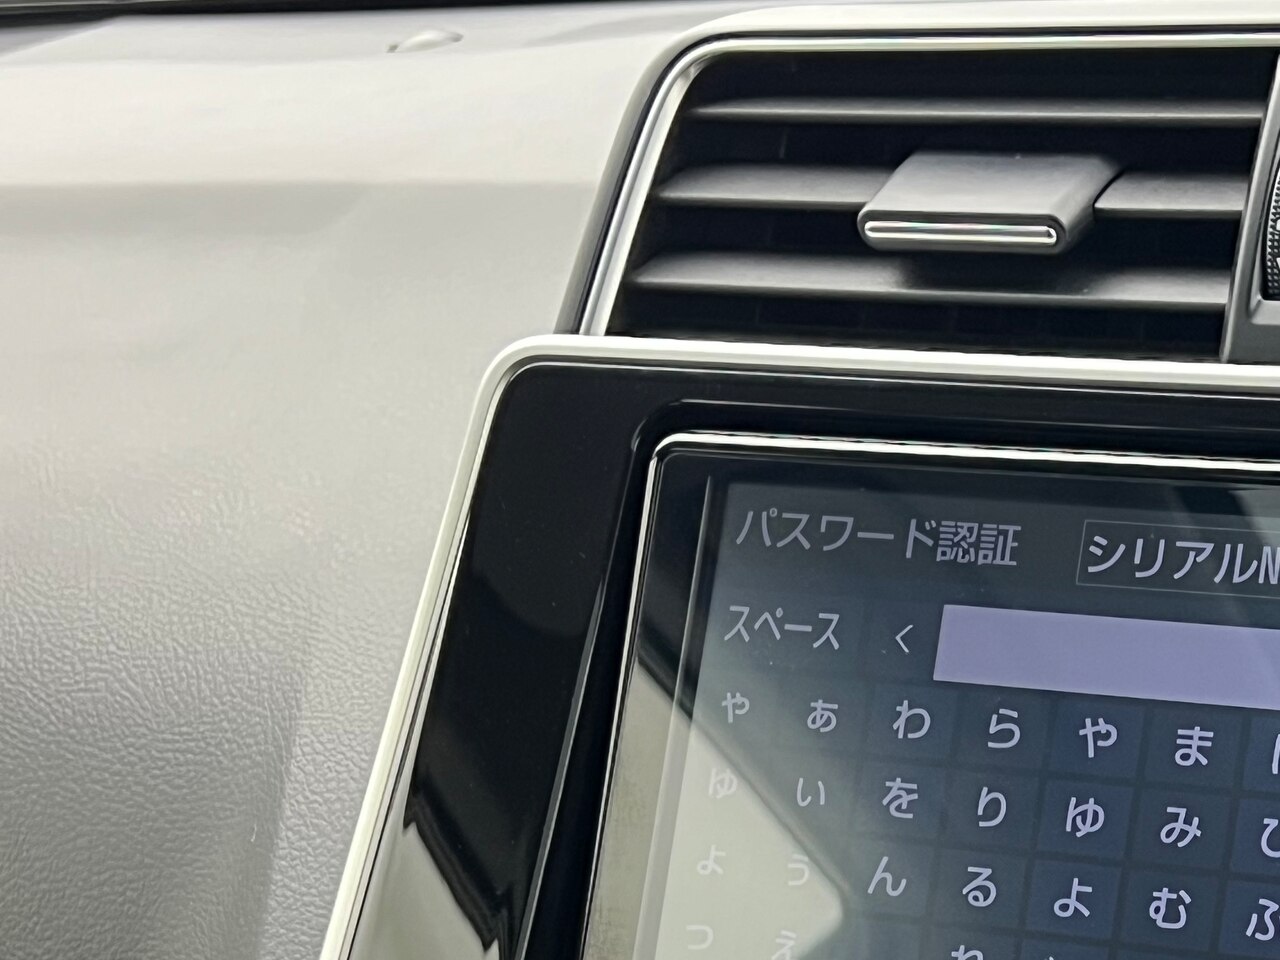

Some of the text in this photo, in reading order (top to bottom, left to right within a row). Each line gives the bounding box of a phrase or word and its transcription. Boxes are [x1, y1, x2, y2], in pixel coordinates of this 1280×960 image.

[735, 506, 1022, 567] パスワード認証
[723, 605, 841, 651] スペース
[892, 700, 931, 740] わ
[987, 708, 1021, 749] ら
[1079, 717, 1118, 758] や
[1174, 726, 1214, 767] ま
[882, 777, 919, 819] を
[977, 786, 1008, 827] り
[1065, 796, 1105, 838] ゆ
[1160, 805, 1202, 848] み
[867, 856, 907, 897] ん
[961, 865, 997, 908] る
[1053, 877, 1093, 918] よ
[1148, 887, 1192, 930] む
